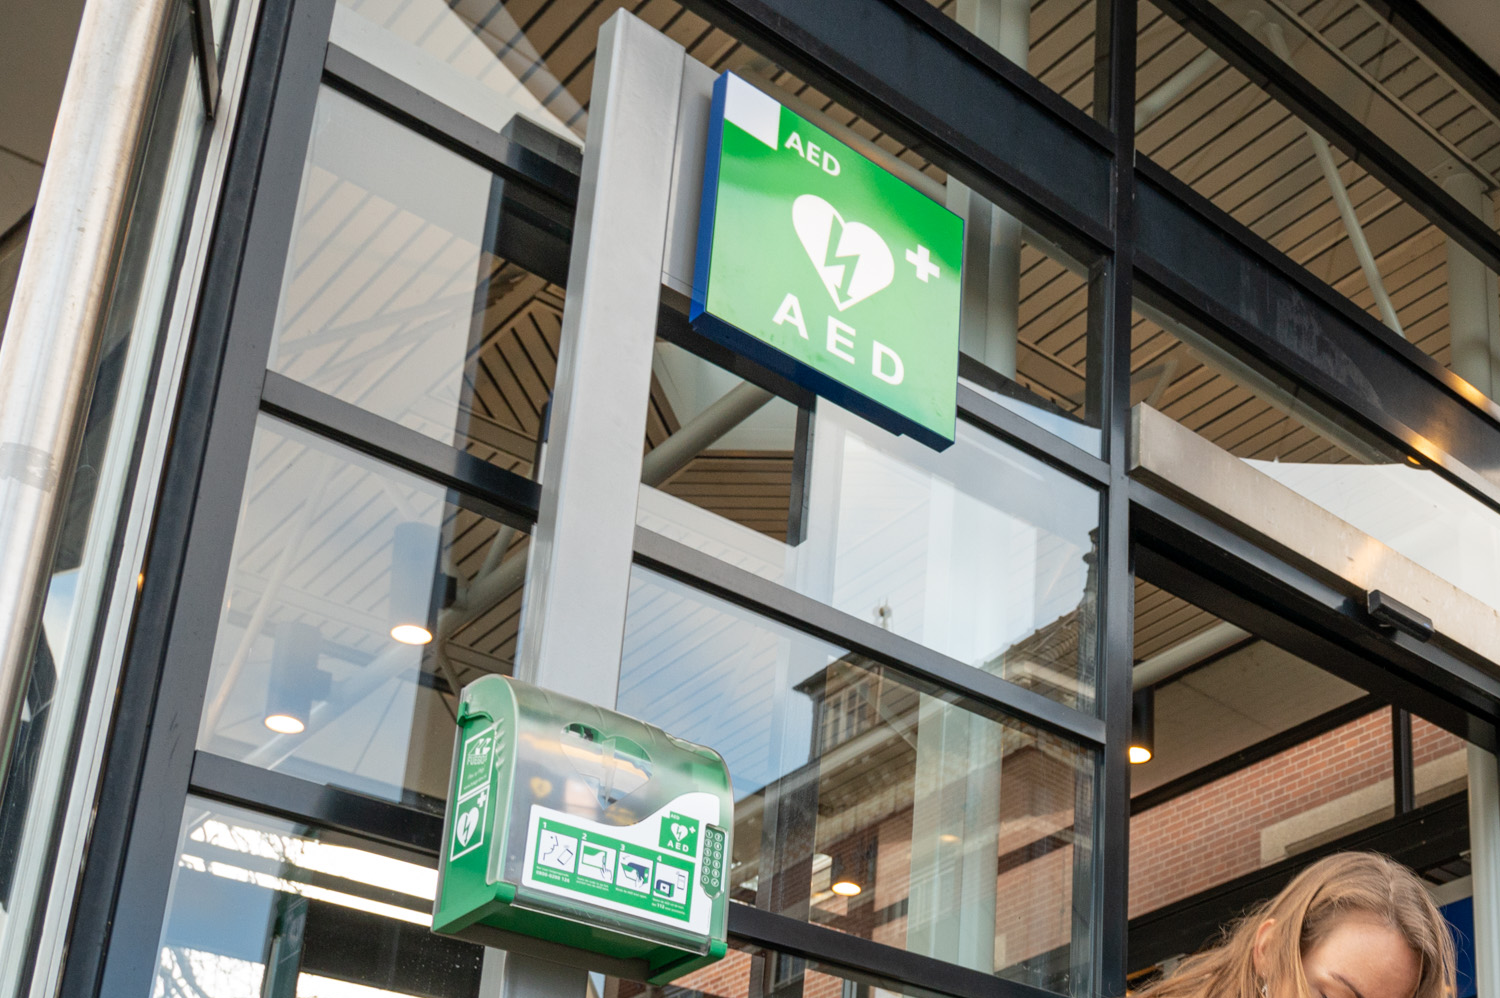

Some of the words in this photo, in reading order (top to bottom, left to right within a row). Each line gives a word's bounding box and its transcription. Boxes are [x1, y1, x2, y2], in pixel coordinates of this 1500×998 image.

[784, 131, 841, 177] AED
[772, 292, 905, 386] AED
[542, 821, 547, 829] 1
[581, 832, 588, 841] 2
[620, 843, 626, 852] 3
[667, 839, 689, 853] AED
[656, 854, 662, 862] 4
